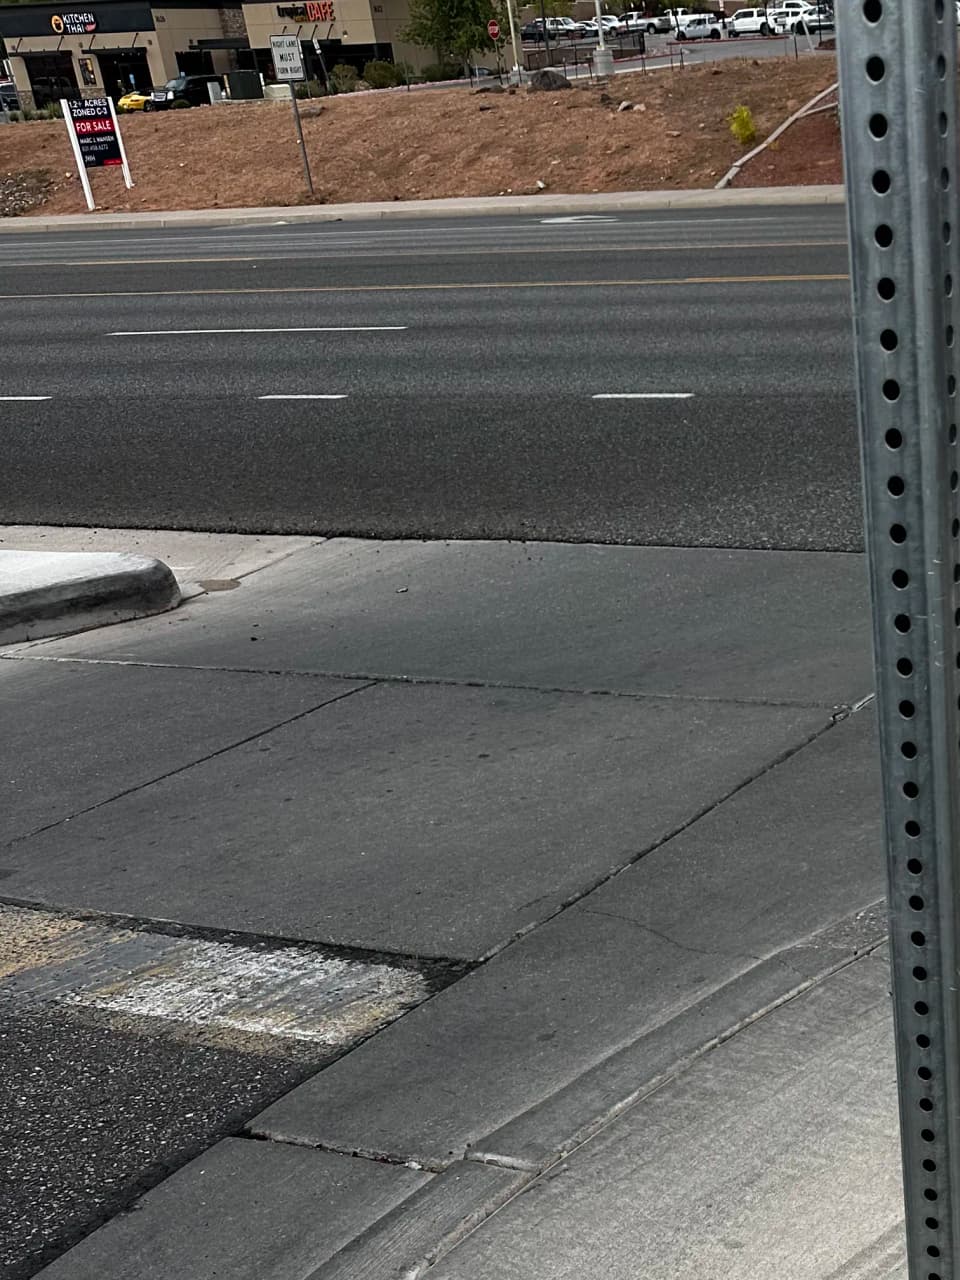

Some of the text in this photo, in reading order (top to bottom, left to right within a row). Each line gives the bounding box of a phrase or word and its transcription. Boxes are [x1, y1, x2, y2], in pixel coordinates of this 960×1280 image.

[62, 13, 94, 24] KITCHEN
[66, 24, 85, 33] THAI
[279, 53, 295, 62] MUST
[84, 98, 107, 107] ACRES
[72, 108, 96, 117] ZONED
[75, 120, 112, 132] FOR SALE
